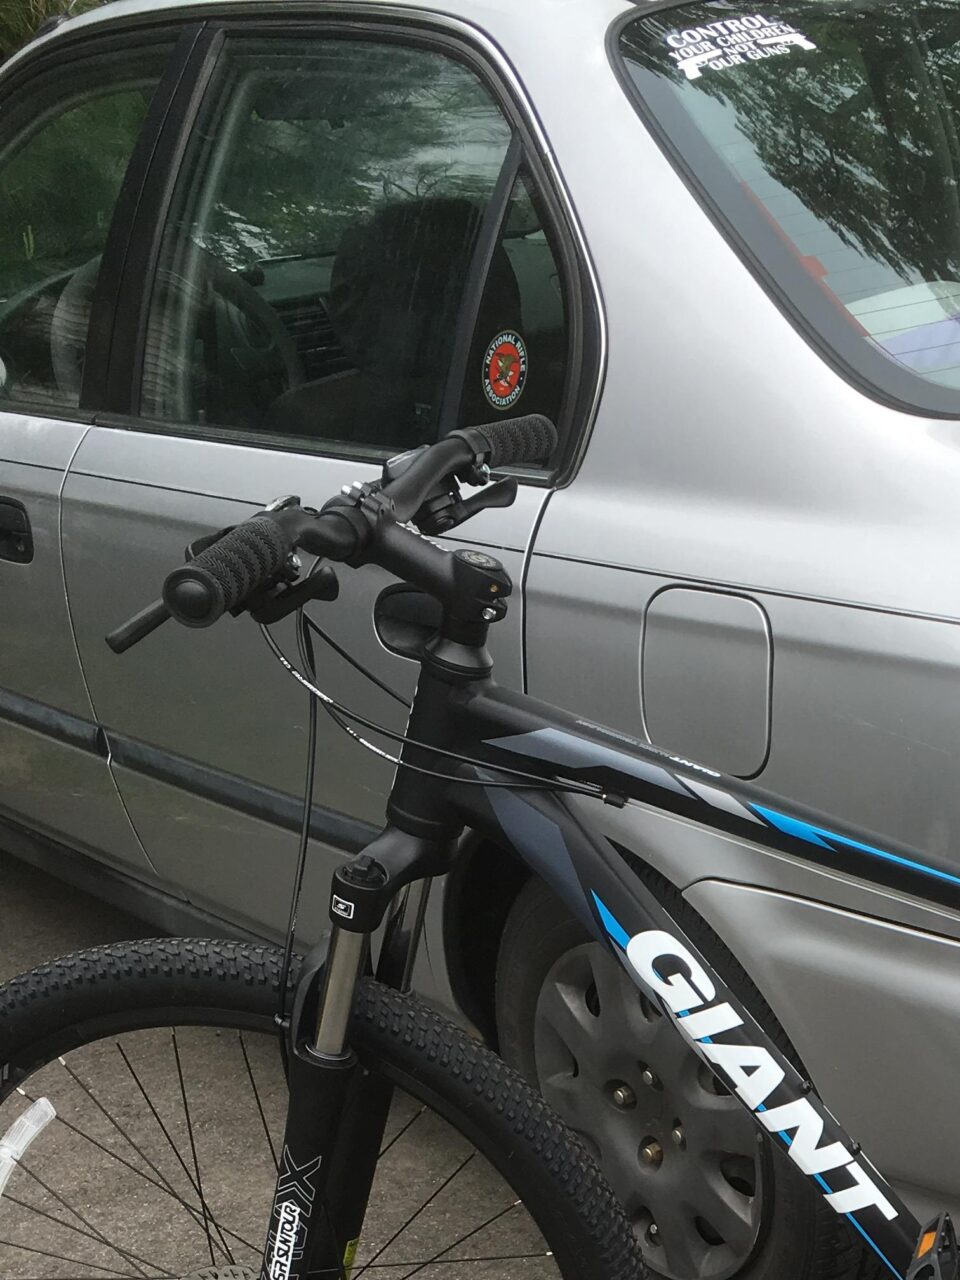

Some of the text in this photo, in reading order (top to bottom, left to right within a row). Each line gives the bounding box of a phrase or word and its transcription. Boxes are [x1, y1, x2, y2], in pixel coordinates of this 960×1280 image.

[666, 15, 777, 48] CONTROL
[668, 24, 796, 61] YOUR CHILDREN
[722, 41, 758, 56] NOT
[708, 44, 790, 71] OUR GUNS
[486, 334, 526, 371] NATIONAL RIFLE
[484, 379, 520, 405] ASSOCIATION
[625, 929, 899, 1220] GIANT
[276, 1204, 298, 1261] SUNTOUR
